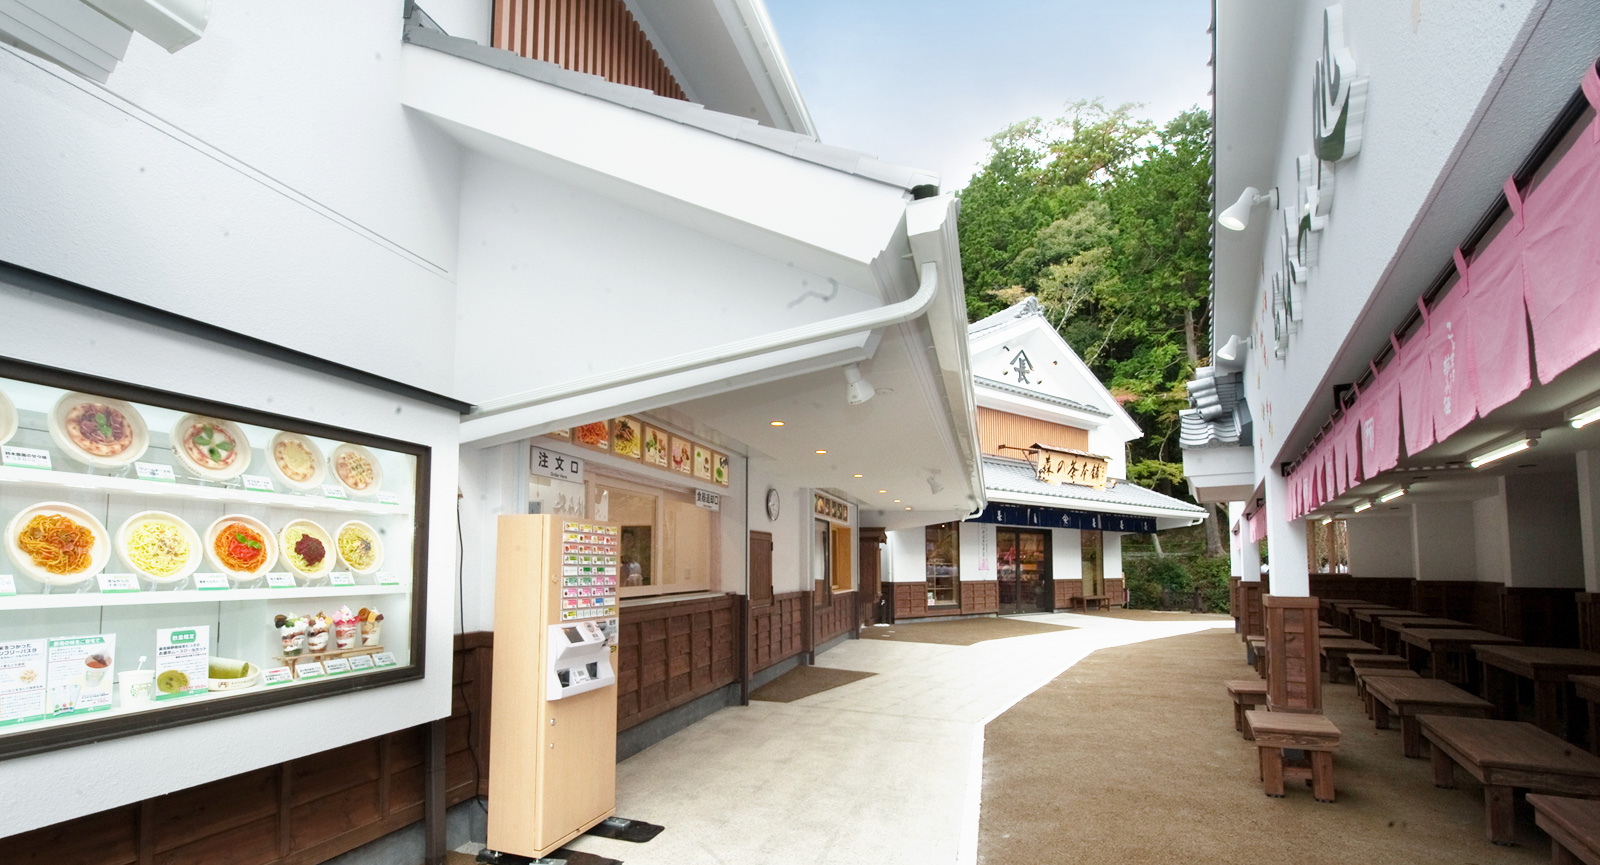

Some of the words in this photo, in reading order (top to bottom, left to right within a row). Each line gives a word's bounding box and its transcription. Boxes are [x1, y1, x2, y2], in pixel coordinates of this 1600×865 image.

[538, 451, 579, 474] 注文口
[697, 491, 719, 505] 食器返却口
